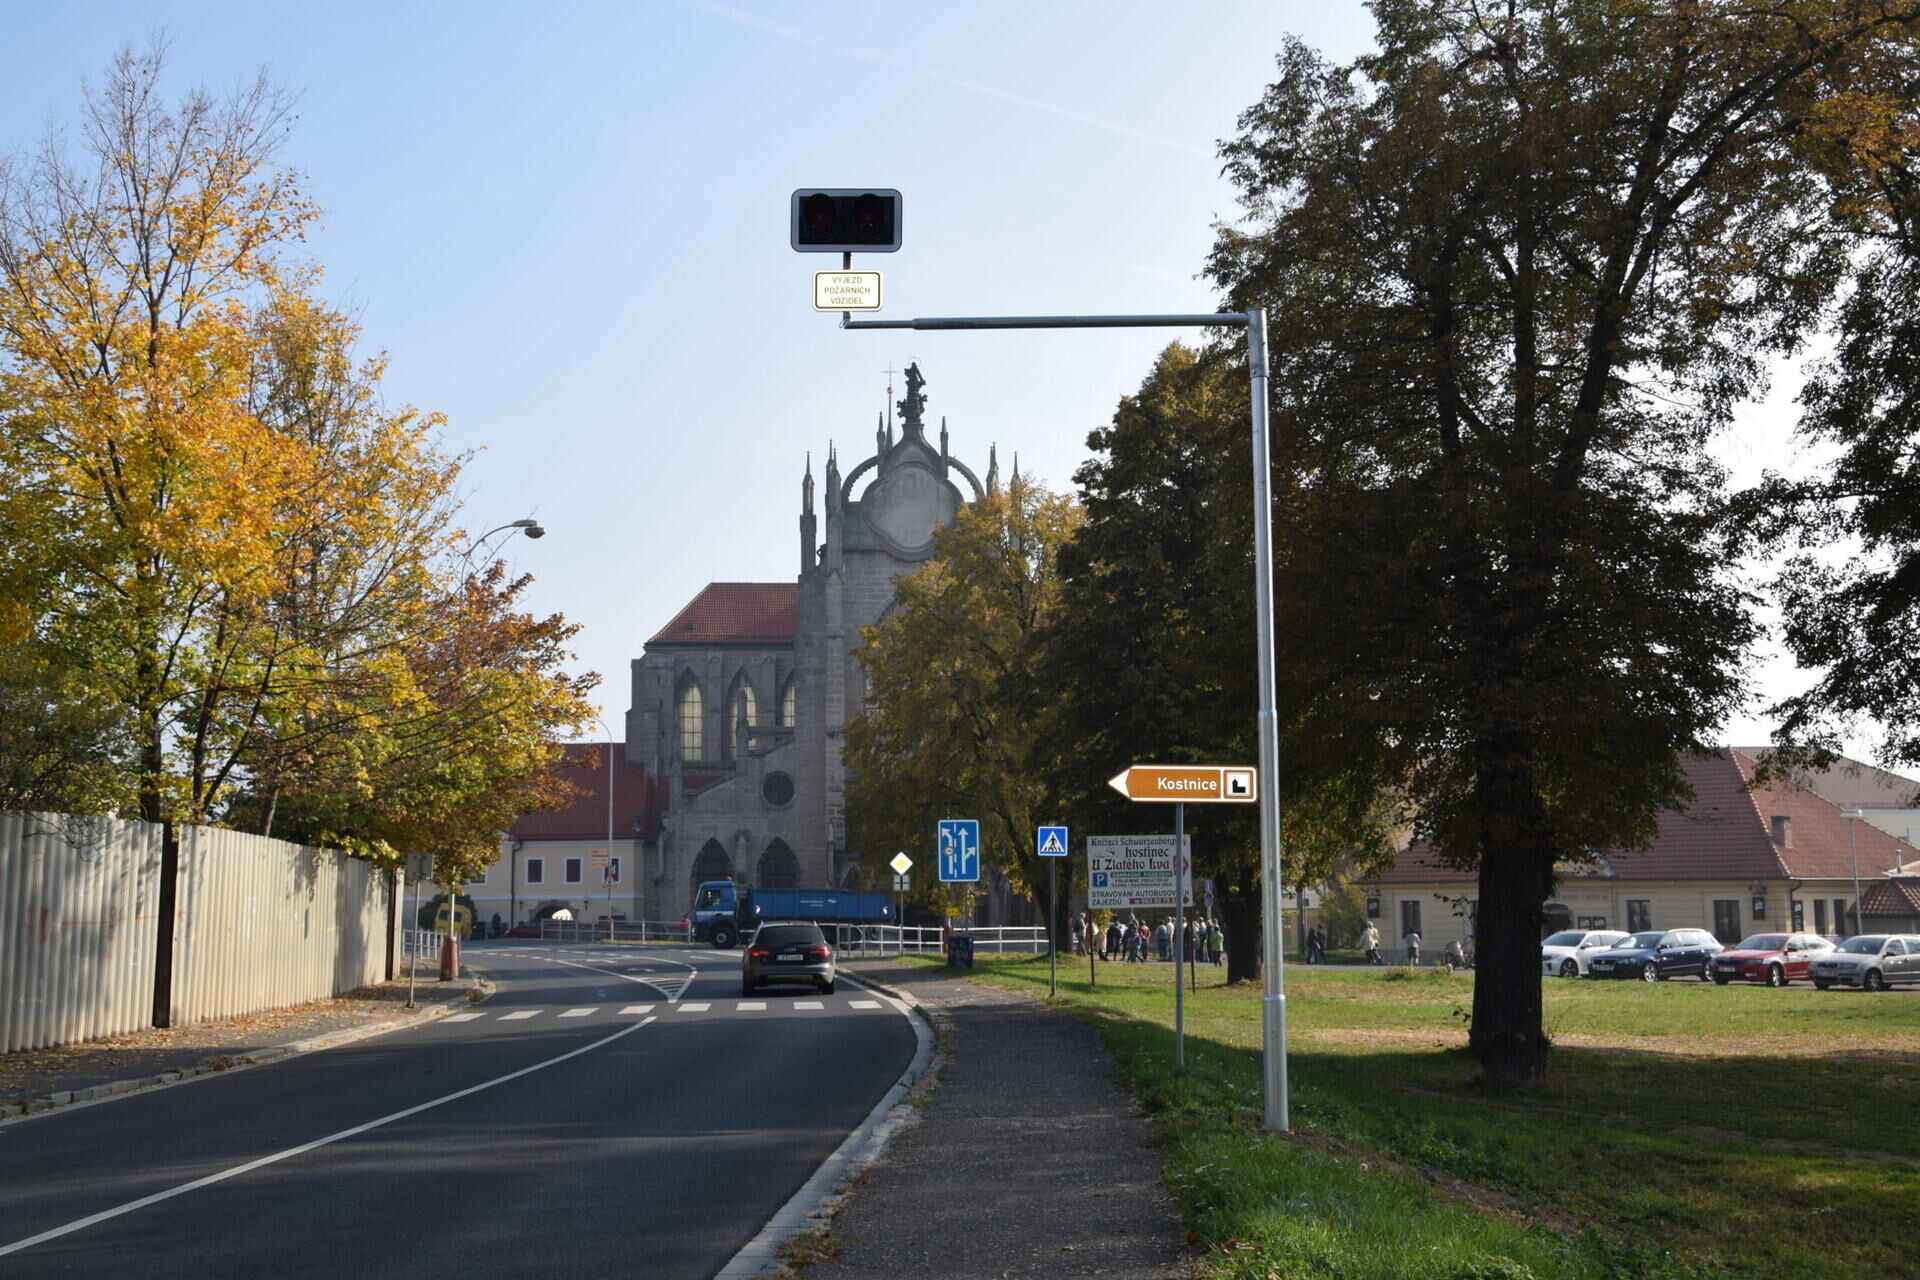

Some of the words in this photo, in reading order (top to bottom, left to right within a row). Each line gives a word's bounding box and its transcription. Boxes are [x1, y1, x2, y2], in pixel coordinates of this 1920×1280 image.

[830, 296, 864, 305] VOZIDEL
[1157, 777, 1217, 790] Kostnice
[1125, 846, 1169, 858] hostinec
[1092, 858, 1100, 870] U
[1105, 858, 1145, 870] Zlatého
[1097, 874, 1104, 885] P
[1136, 889, 1190, 897] AUTOBUSOVH
